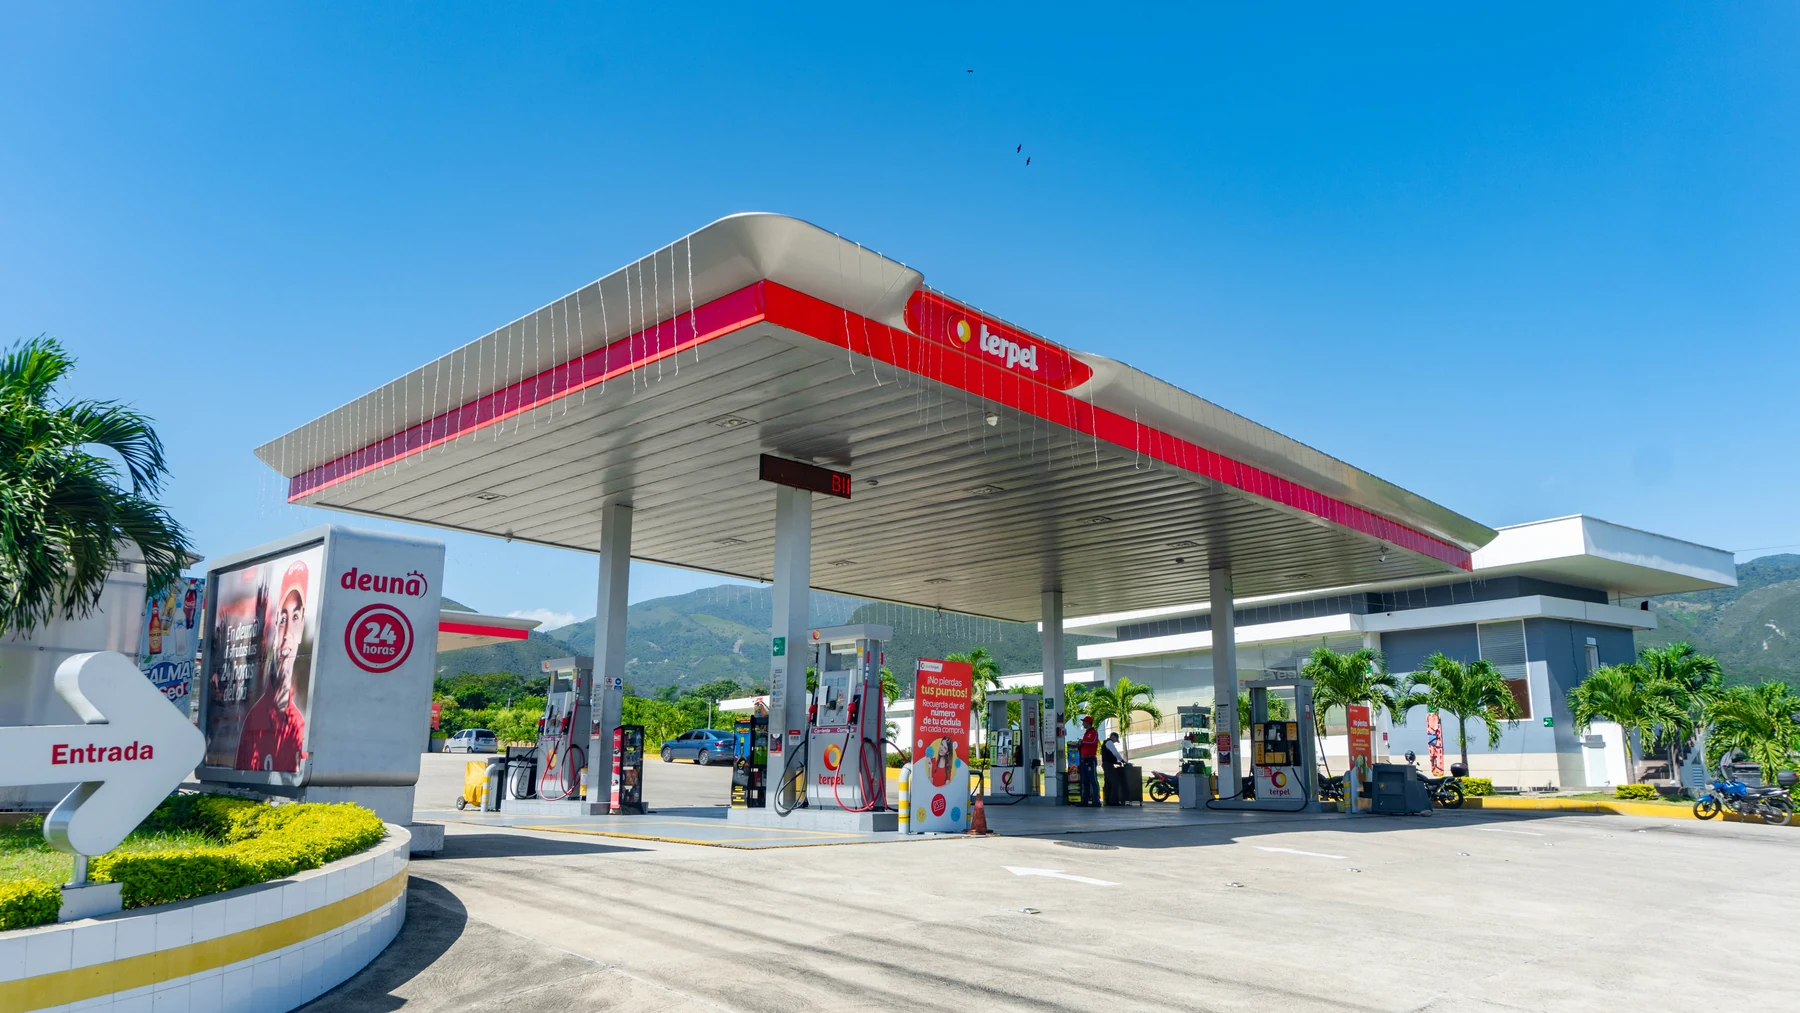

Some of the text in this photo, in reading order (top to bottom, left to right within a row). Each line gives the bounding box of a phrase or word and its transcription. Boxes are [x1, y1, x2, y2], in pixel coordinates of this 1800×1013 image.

[980, 323, 1039, 372] terpel
[364, 621, 397, 645] 24
[363, 643, 395, 655] horas
[939, 677, 962, 687] pierdas
[921, 685, 968, 698] tus puntos!
[922, 699, 948, 709] Recuerda
[930, 708, 956, 717] número
[923, 716, 962, 726] de tu cédula
[992, 734, 997, 742] 4
[52, 741, 154, 765] Entrada
[1269, 788, 1291, 797] terpel
